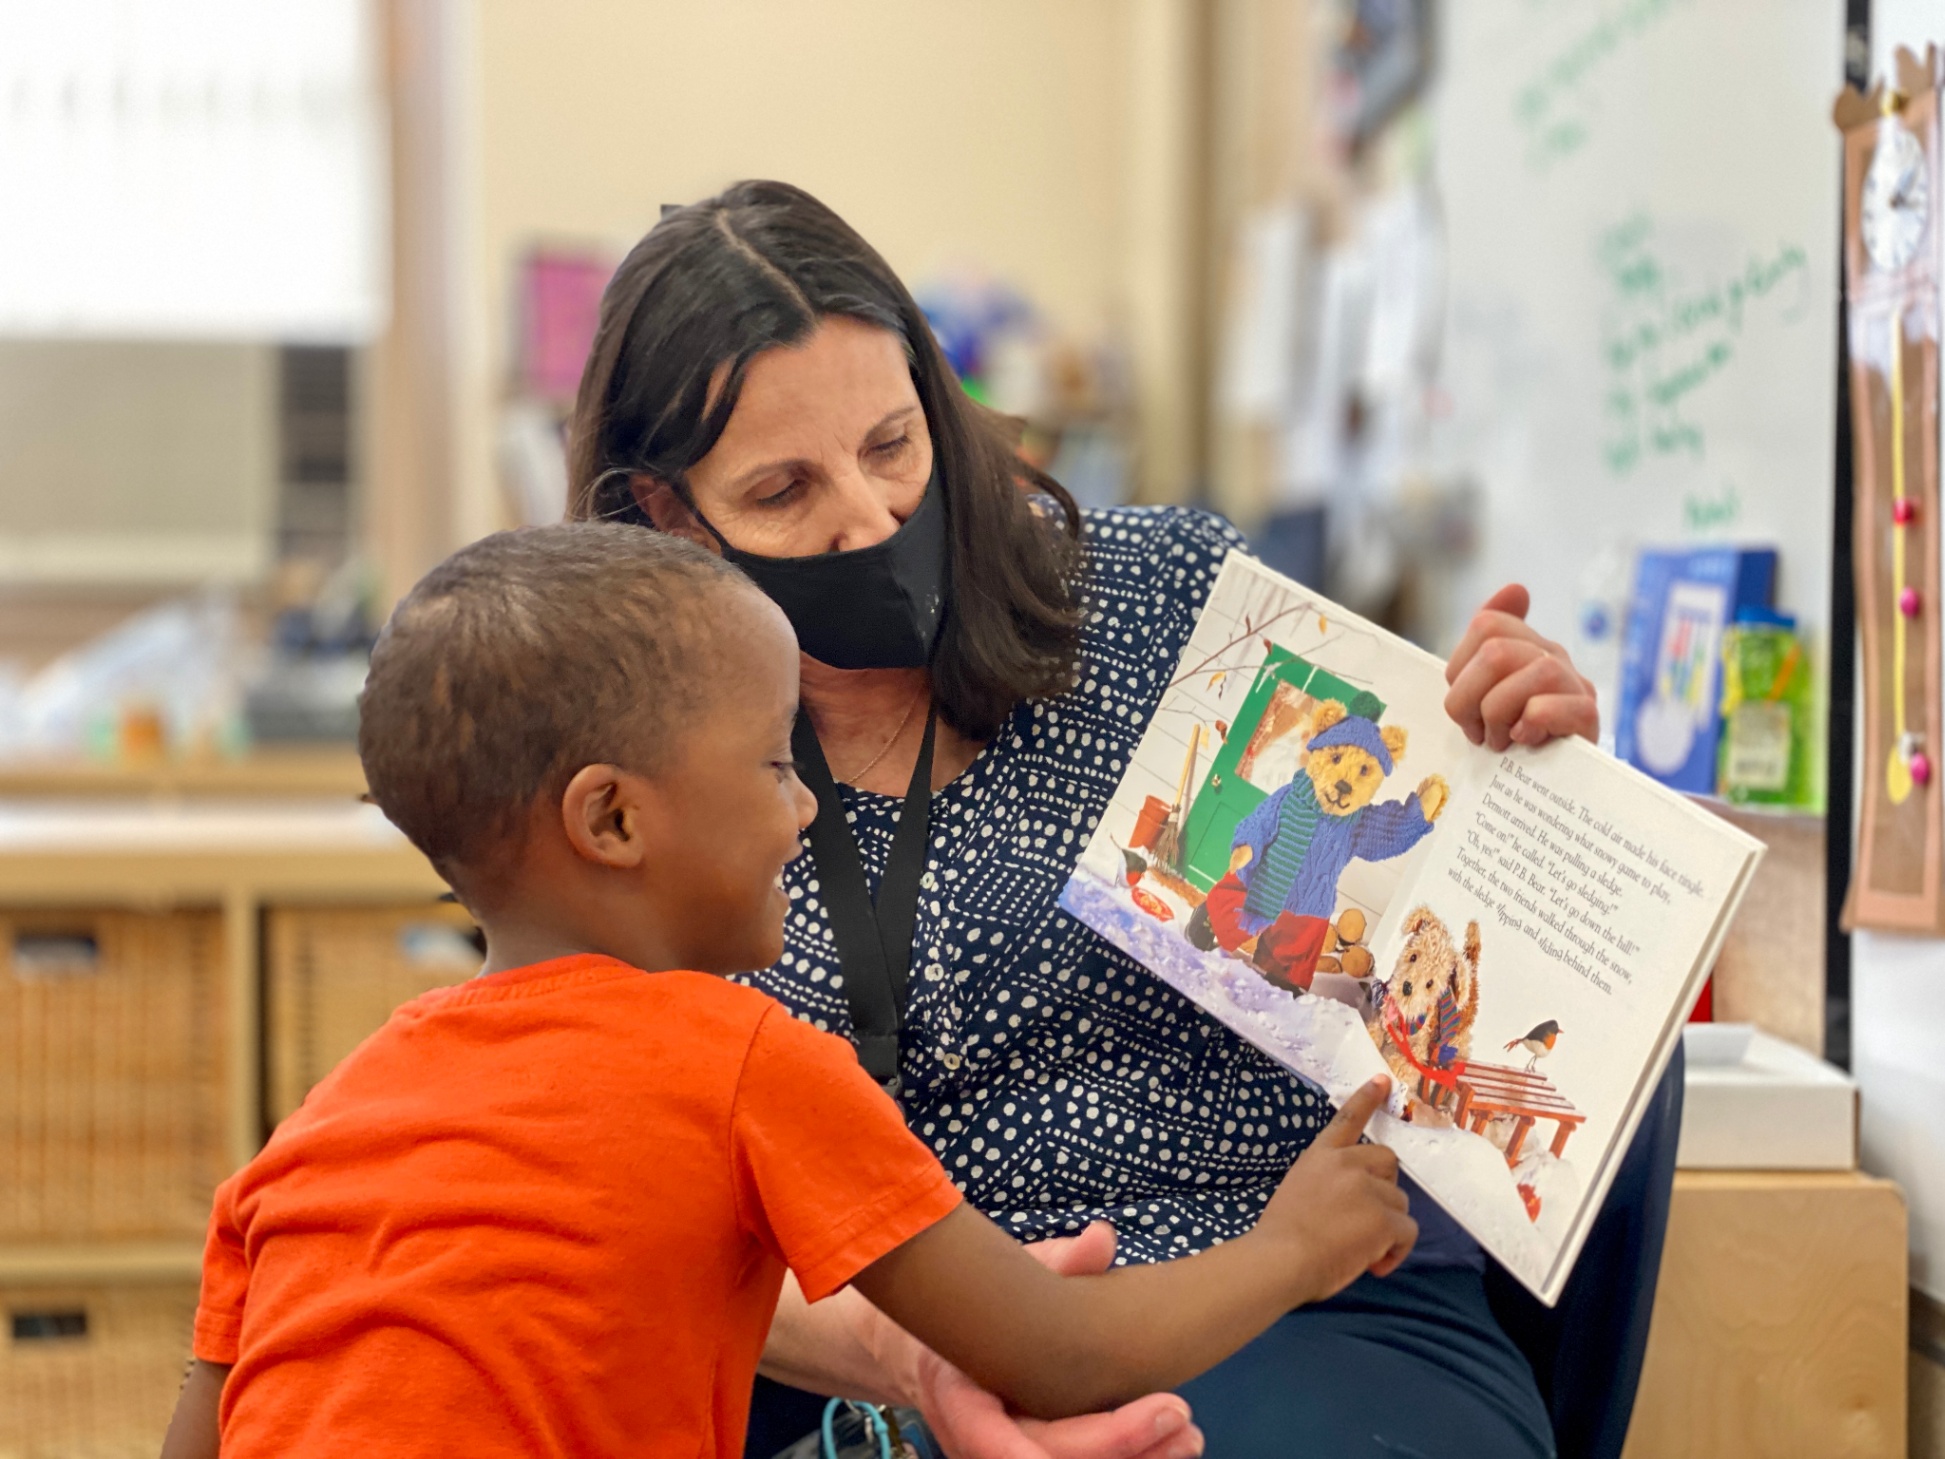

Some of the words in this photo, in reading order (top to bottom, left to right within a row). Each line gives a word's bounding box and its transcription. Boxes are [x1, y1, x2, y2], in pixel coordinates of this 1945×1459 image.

[1476, 811, 1496, 834] “Come
[1512, 837, 1521, 852] he
[1522, 849, 1545, 868] called.
[1566, 880, 1577, 891] go
[1482, 793, 1511, 820] Dermott
[1510, 816, 1537, 838] arrived.
[1537, 830, 1549, 846] He
[1550, 842, 1564, 856] was
[1562, 852, 1590, 876] pulling
[1590, 870, 1597, 879] a
[1597, 872, 1622, 896] sledge.
[1489, 775, 1505, 792] Just
[1504, 788, 1513, 797] as
[1513, 789, 1523, 804] he
[1524, 800, 1537, 813] was
[1538, 809, 1574, 840] wondering
[1575, 833, 1594, 851] what
[1594, 847, 1618, 868] snowy
[1617, 864, 1641, 882] game
[1641, 877, 1651, 888] to
[1649, 883, 1670, 904] play,
[1500, 757, 1514, 774] P.B.
[1514, 766, 1532, 785] Bear
[1532, 781, 1549, 797] went
[1549, 793, 1575, 815] outside.
[1578, 806, 1593, 825] The
[1593, 822, 1613, 837] cold
[1610, 833, 1623, 844] air
[1623, 840, 1646, 859] made
[1645, 850, 1659, 867] his
[1659, 860, 1677, 880] face
[1448, 868, 1462, 884] with
[1462, 877, 1474, 892] the
[1474, 885, 1495, 908] sledge
[1497, 903, 1522, 930] slipping
[1523, 925, 1541, 940] and
[1538, 937, 1563, 961] sliding
[1563, 950, 1592, 978] behind
[1590, 971, 1611, 995] them.
[1457, 846, 1486, 878] Together,
[1488, 871, 1499, 886] the
[1500, 882, 1513, 896] two
[1513, 889, 1537, 914] friends
[1538, 910, 1566, 933] walked
[1564, 926, 1595, 956] through
[1596, 949, 1609, 965] the
[1610, 962, 1631, 984] snow,
[1498, 856, 1514, 871] said
[1512, 863, 1527, 881] P.B.
[1527, 873, 1545, 895] Bear.
[1568, 907, 1580, 918] go
[1580, 911, 1601, 934] down
[1602, 927, 1616, 944] the
